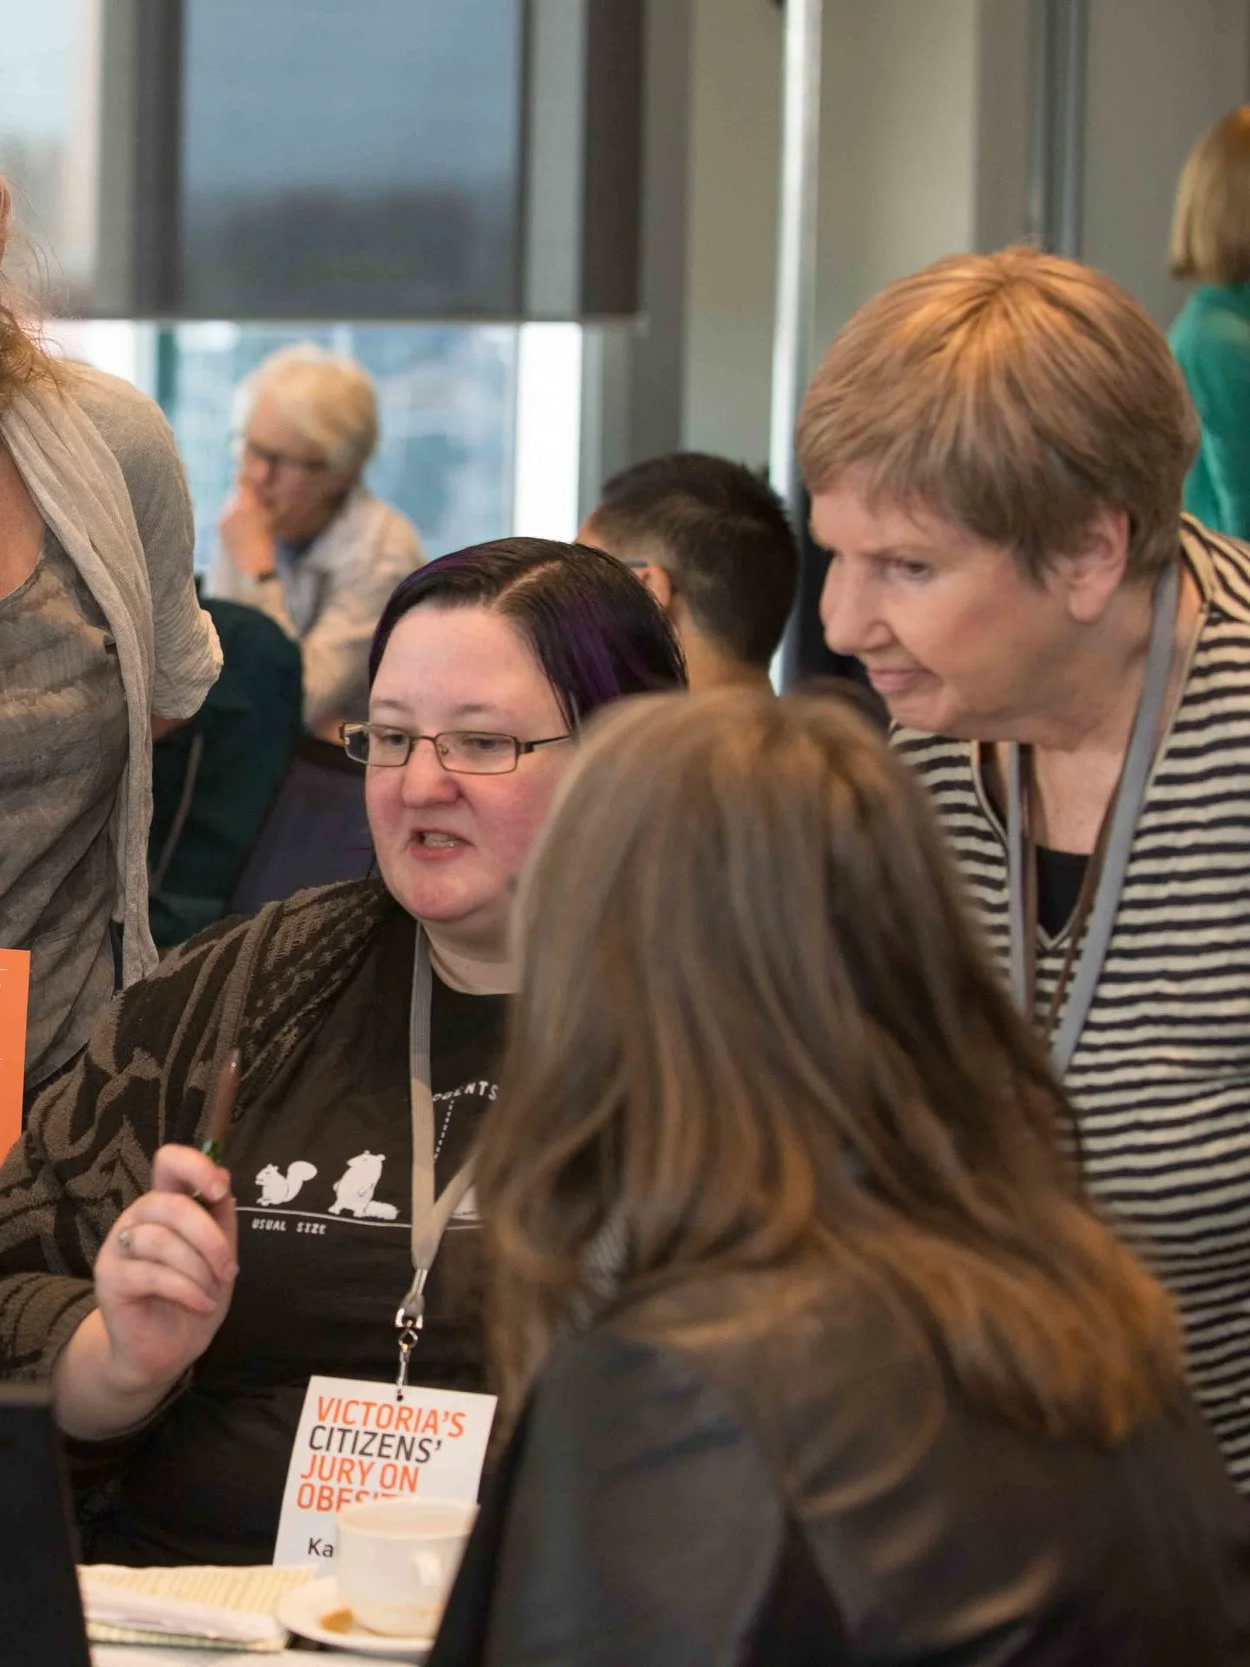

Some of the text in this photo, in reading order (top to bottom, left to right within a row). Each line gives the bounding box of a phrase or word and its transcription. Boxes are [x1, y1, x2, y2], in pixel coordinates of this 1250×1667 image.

[432, 1081, 498, 1101] ODENTS
[252, 1218, 327, 1235] USUAL SIZE
[317, 1396, 467, 1439] VICTORIA'S
[309, 1425, 443, 1464] CITIZENS'
[300, 1454, 420, 1494] JURY ON
[307, 1537, 334, 1559] Ka
